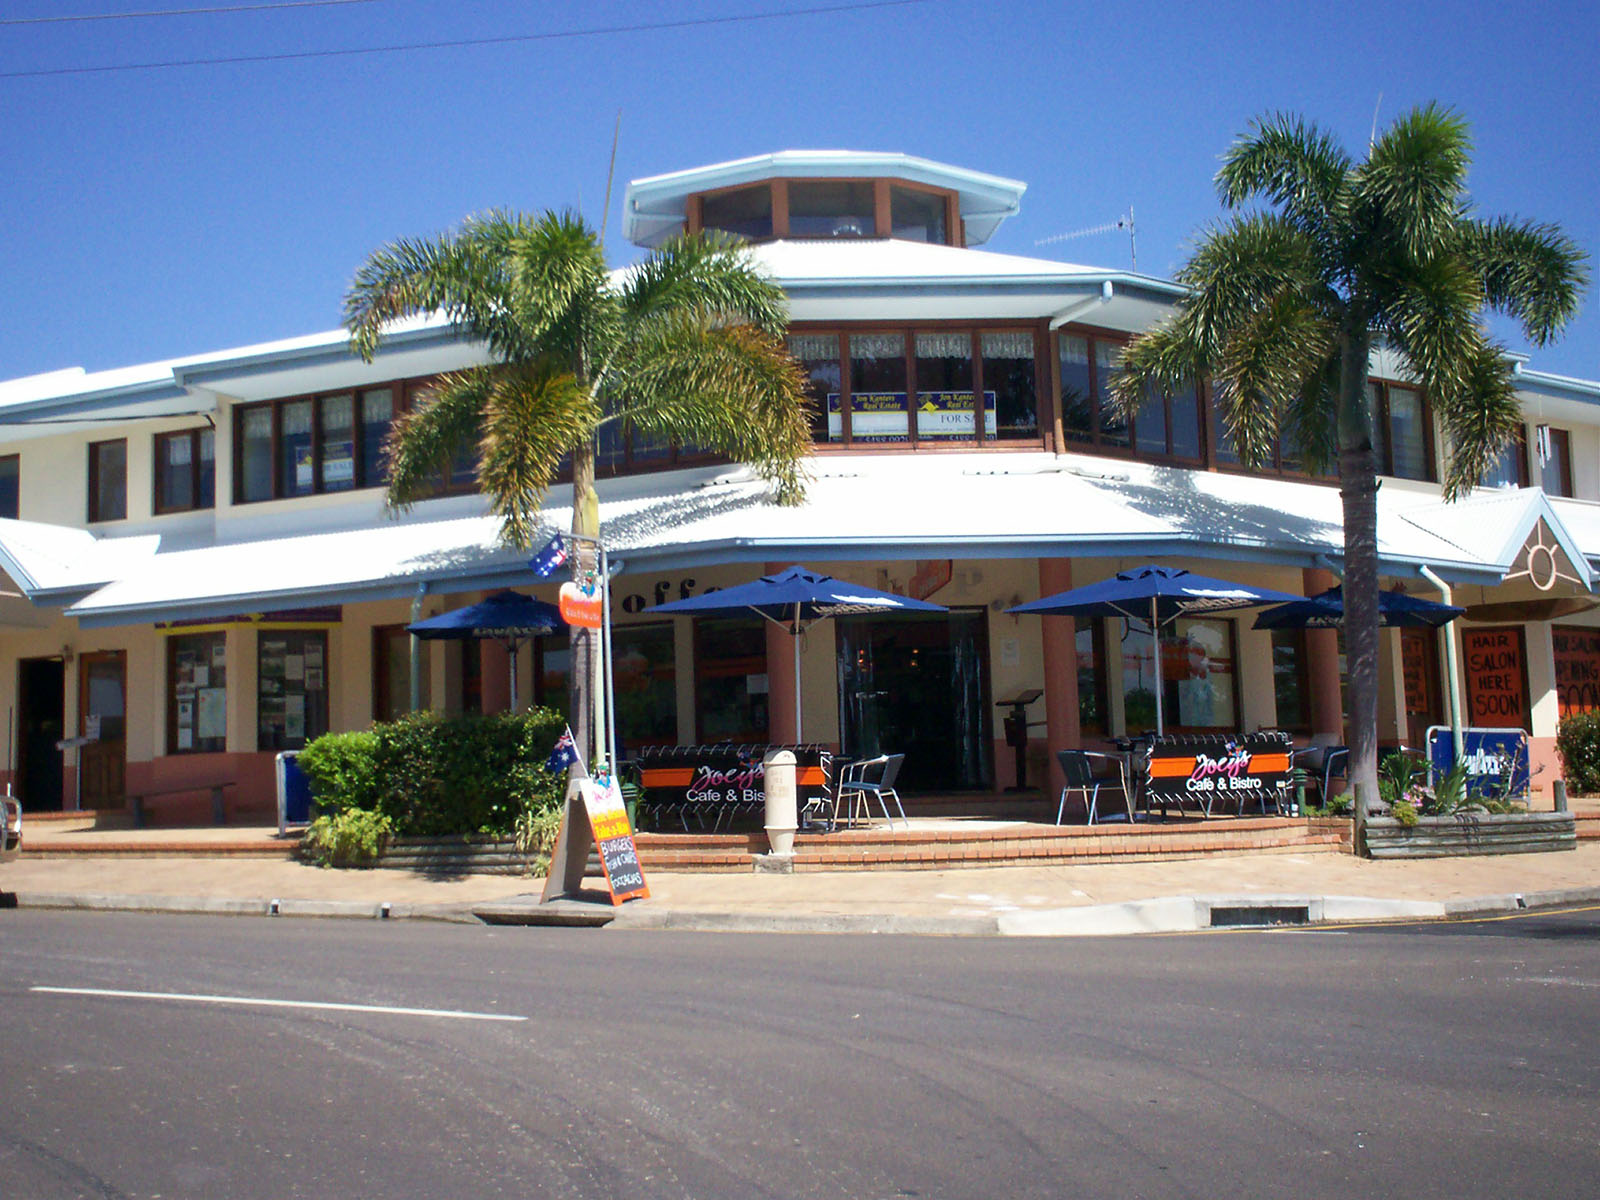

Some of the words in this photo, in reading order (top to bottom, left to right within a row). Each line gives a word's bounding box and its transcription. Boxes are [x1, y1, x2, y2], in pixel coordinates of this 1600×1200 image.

[941, 414, 961, 423] FOR
[964, 414, 991, 423] SE
[1473, 635, 1509, 648] HAIR
[1470, 651, 1517, 673] SALON
[1479, 674, 1513, 691] HERE
[1475, 693, 1520, 717] SOON
[1217, 777, 1227, 790] &
[1230, 776, 1262, 790] Bistro
[686, 789, 721, 802] Cafe
[726, 789, 738, 802] &
[743, 789, 766, 802] Bis
